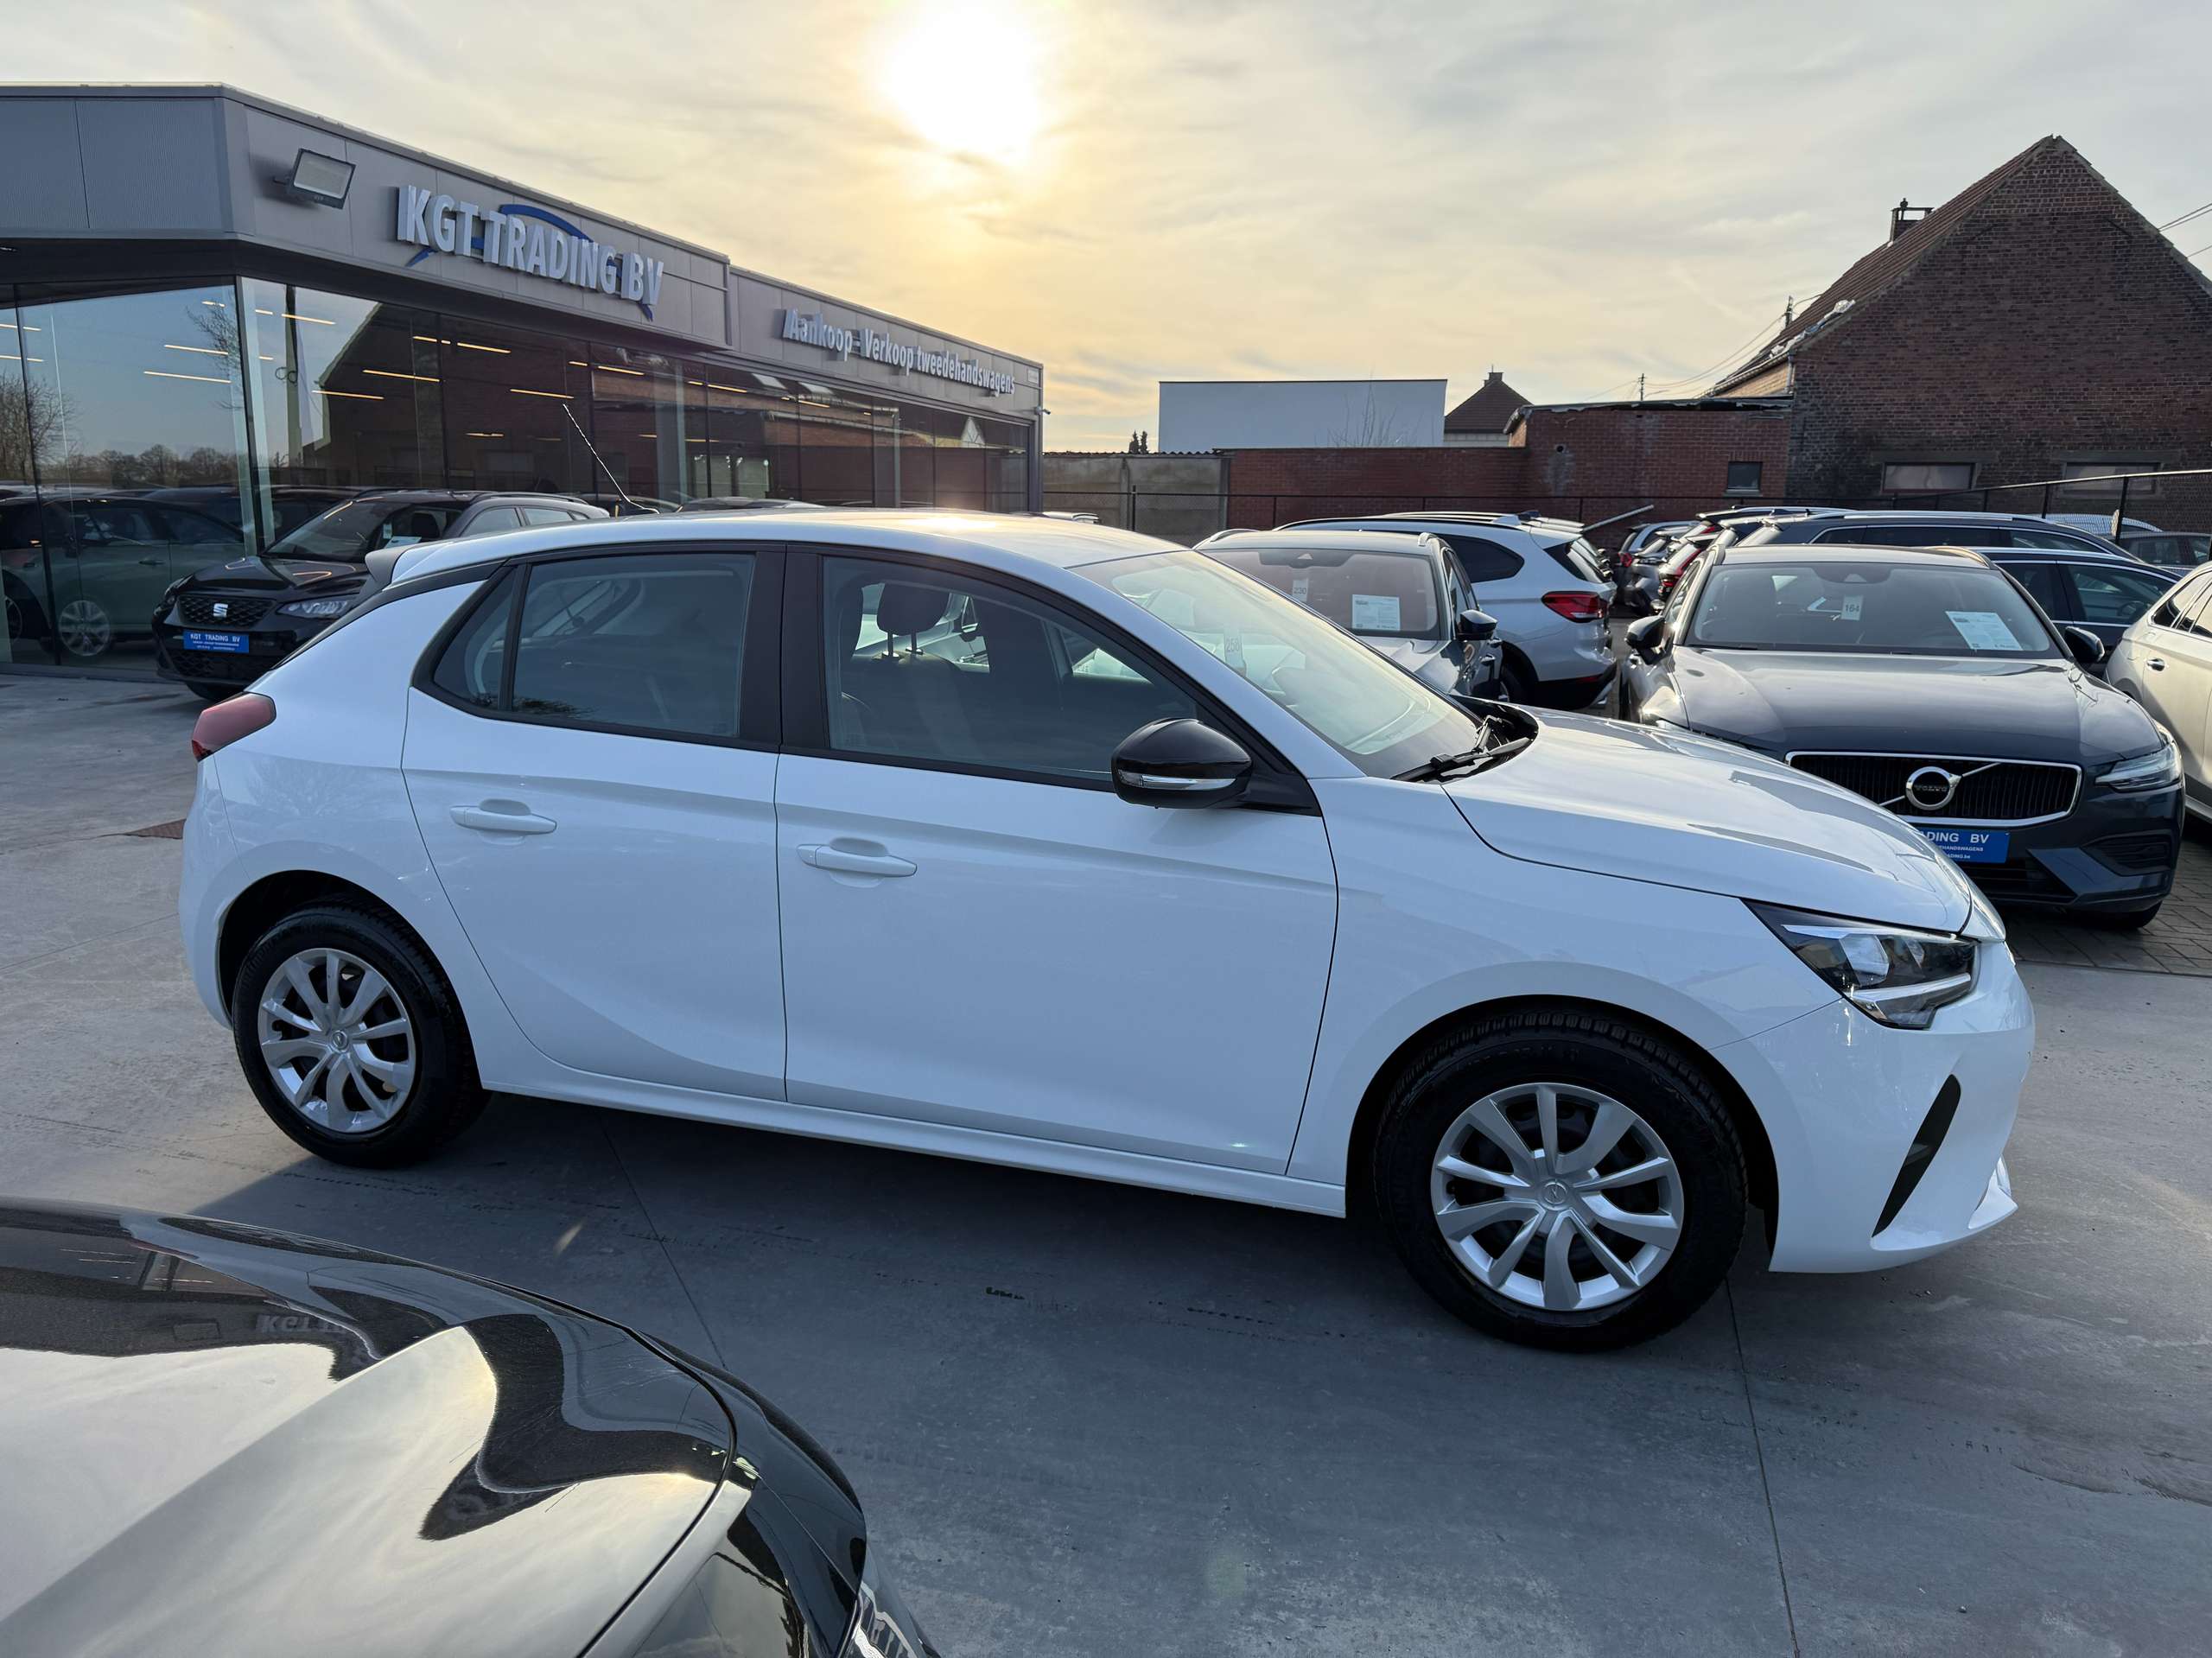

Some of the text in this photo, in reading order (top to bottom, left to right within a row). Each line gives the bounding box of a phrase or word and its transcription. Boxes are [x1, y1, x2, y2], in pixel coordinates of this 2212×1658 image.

[397, 185, 664, 305] KGT TRADING BV
[783, 308, 853, 361] Aankoop
[861, 328, 914, 376] Verkoop
[917, 346, 1015, 397] tweedehandswagens
[1921, 830, 1989, 844] DING BV
